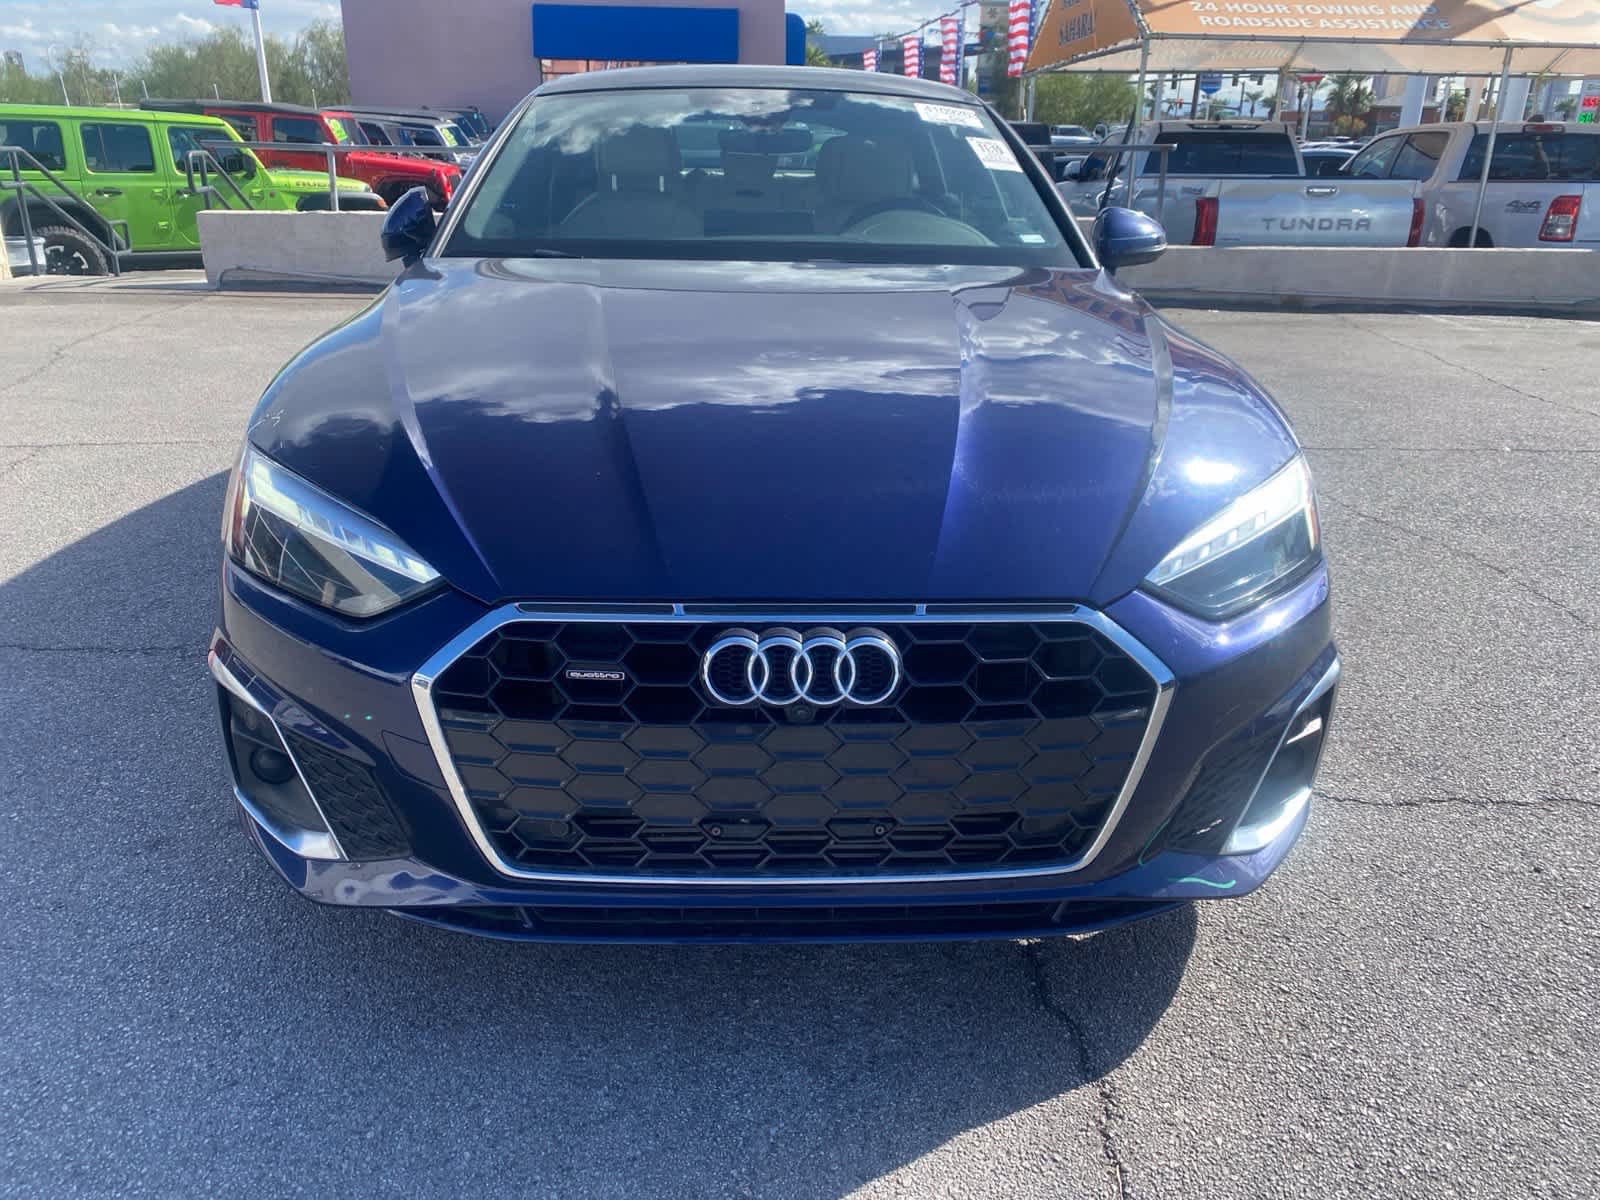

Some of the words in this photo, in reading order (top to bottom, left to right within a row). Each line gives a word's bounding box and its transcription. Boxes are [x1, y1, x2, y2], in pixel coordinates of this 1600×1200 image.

[1191, 1, 1219, 12] 24
[1225, 2, 1291, 14] HOUR
[1296, 3, 1386, 15] TOWING
[1391, 5, 1438, 15] AND
[1199, 15, 1314, 28] ROADSIDE
[1319, 18, 1451, 30] ASSISTANCE
[1262, 217, 1372, 231] TUNDRA
